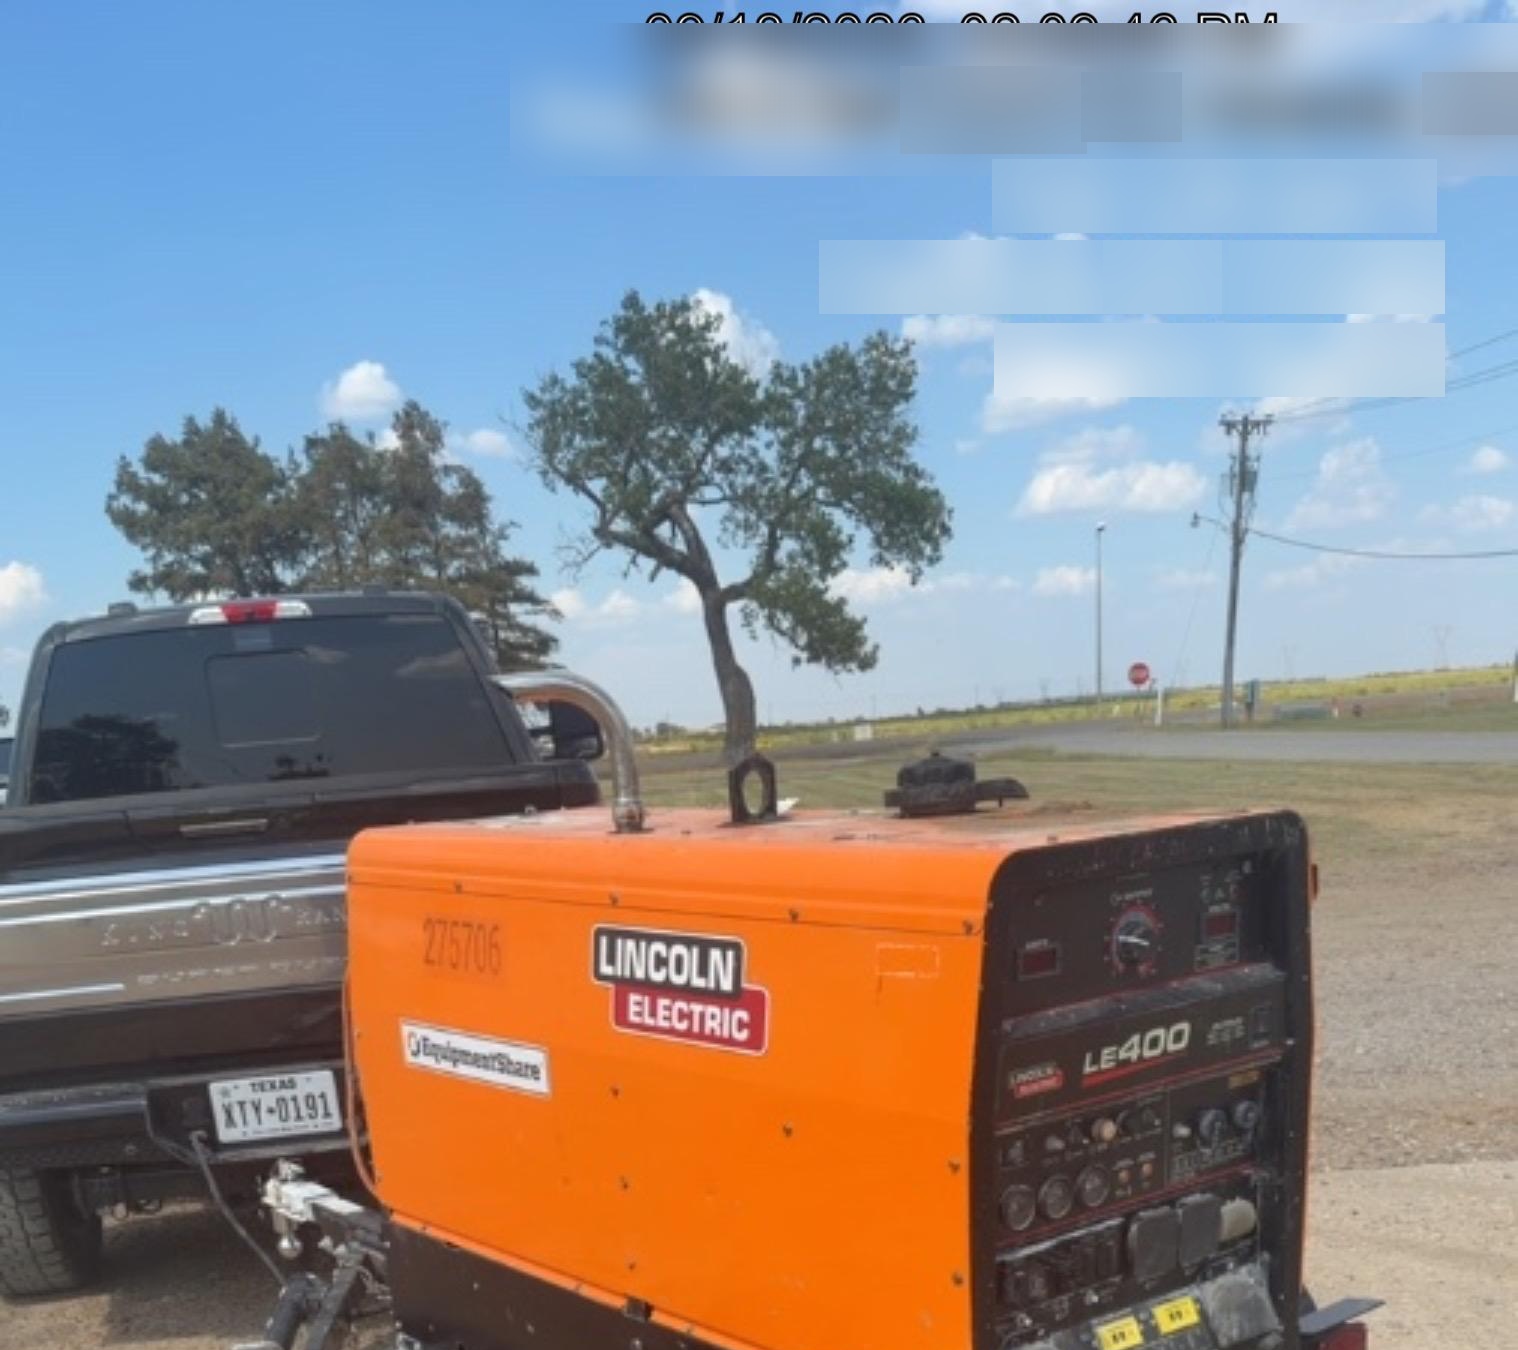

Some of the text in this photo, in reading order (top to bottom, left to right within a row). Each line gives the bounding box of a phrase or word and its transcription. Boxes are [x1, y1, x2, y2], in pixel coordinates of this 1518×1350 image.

[423, 917, 501, 976] 275706
[599, 935, 734, 993] LINCOLN
[628, 992, 750, 1041] ELECTRIC
[423, 1037, 541, 1080] EquipmentShare
[1083, 1021, 1191, 1074] LE400
[248, 1077, 297, 1092] TEXAS
